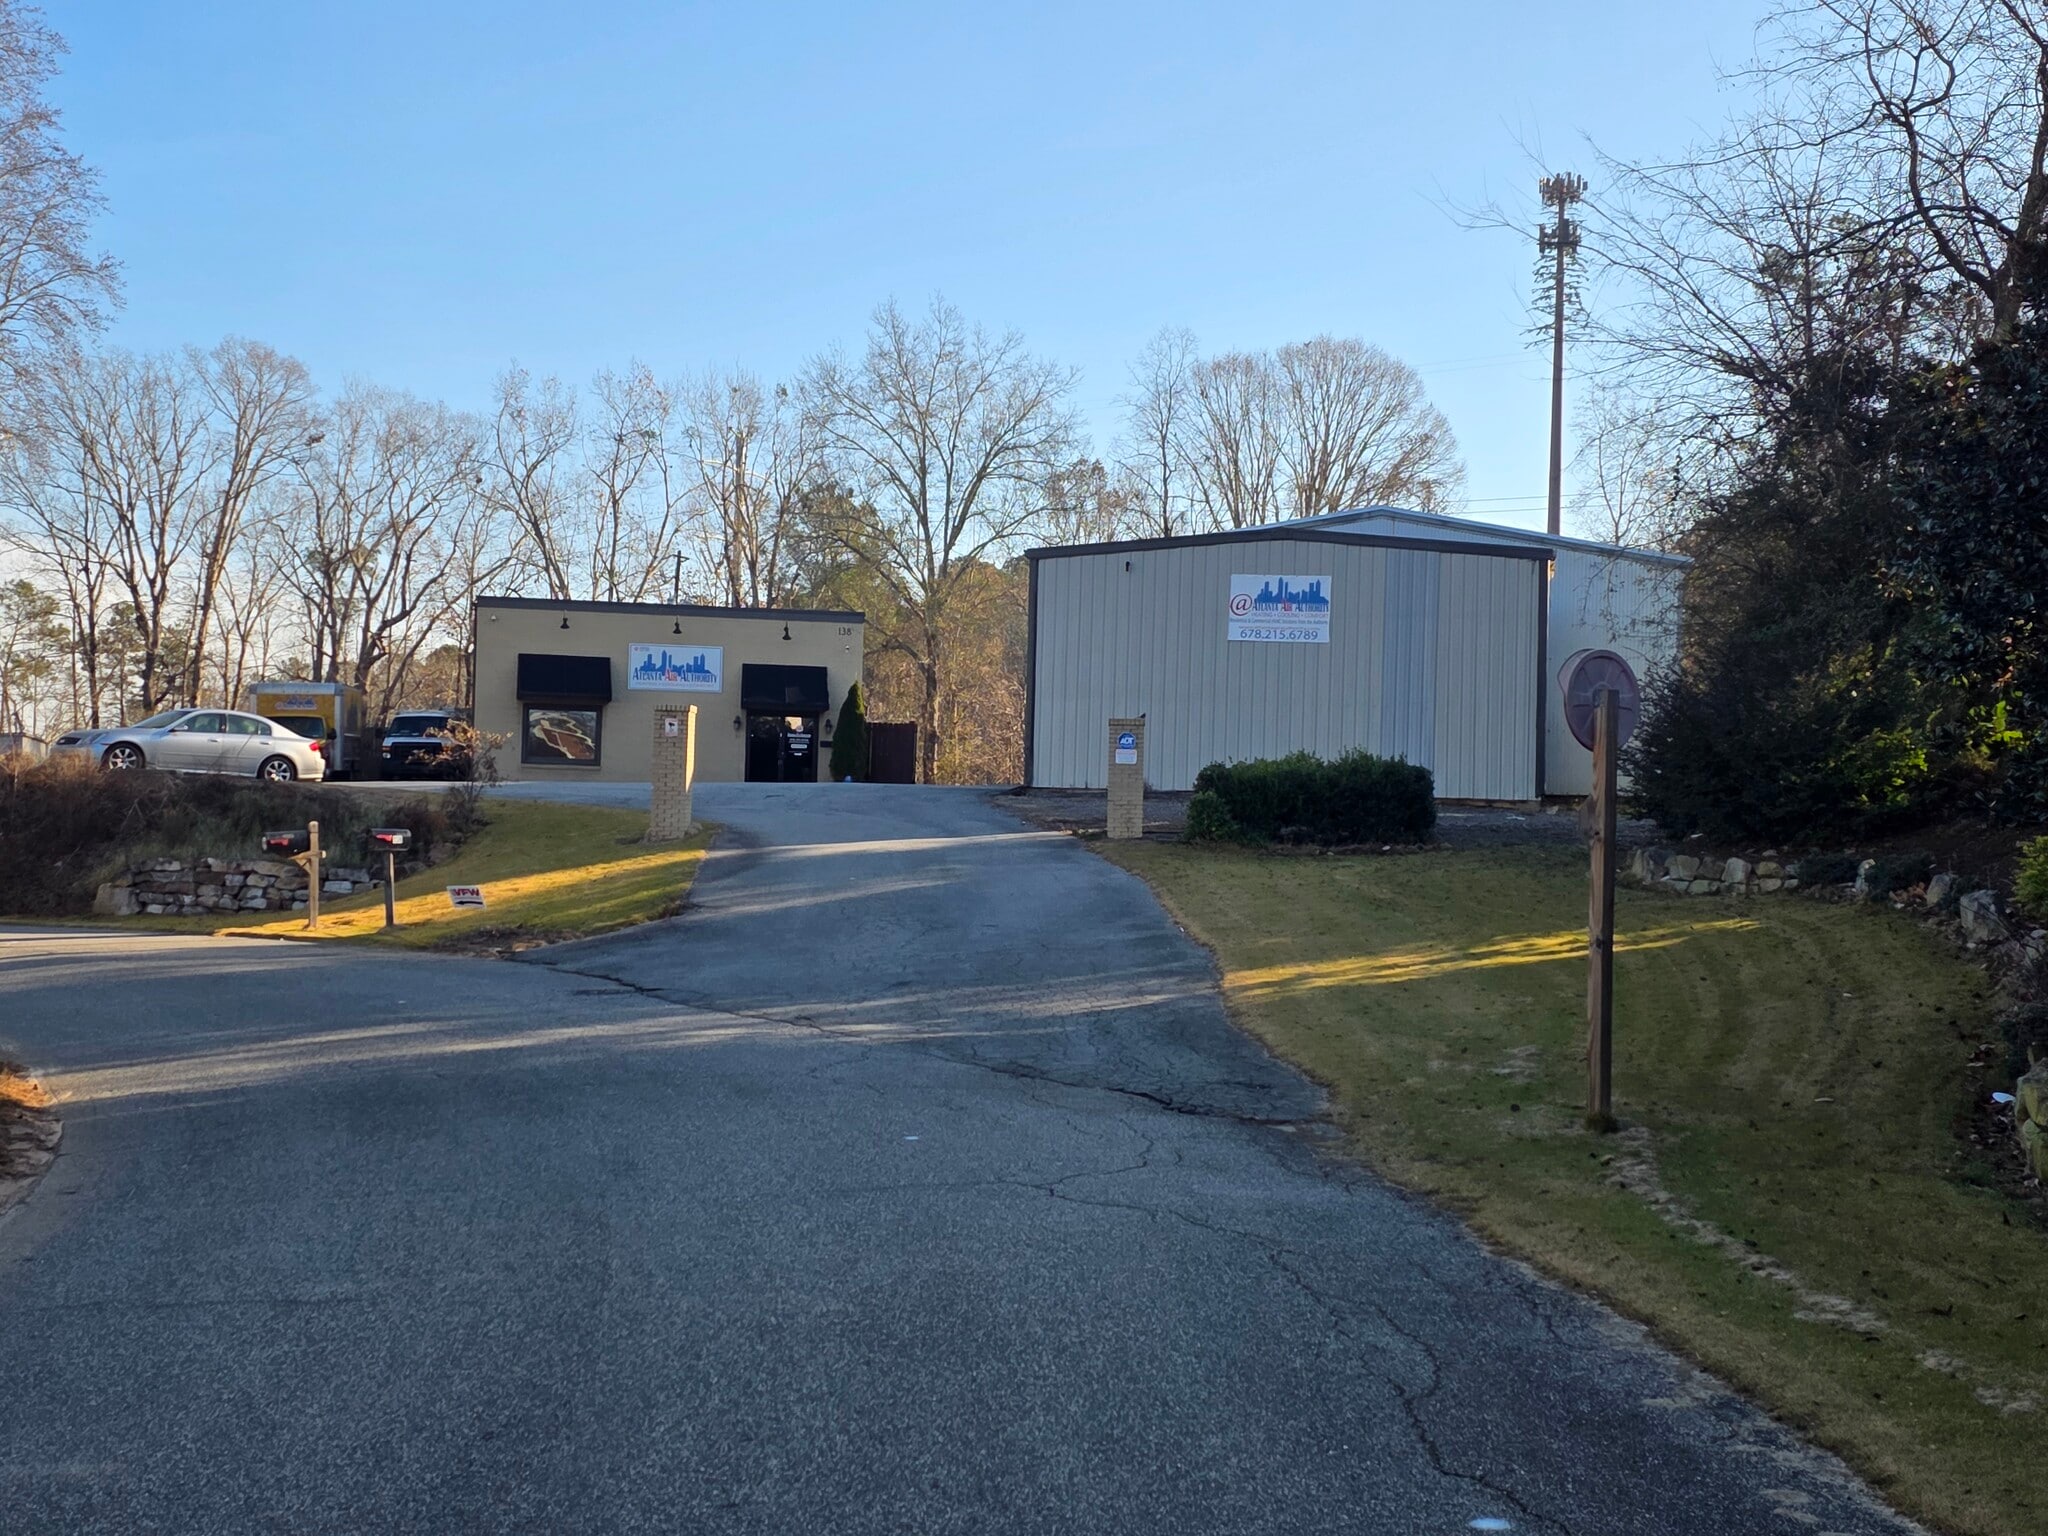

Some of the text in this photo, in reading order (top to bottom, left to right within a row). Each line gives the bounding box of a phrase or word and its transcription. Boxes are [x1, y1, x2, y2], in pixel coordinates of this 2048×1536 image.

[838, 626, 852, 636] 138
[1240, 629, 1318, 640] 678.215.6789
[452, 888, 480, 896] VFW
